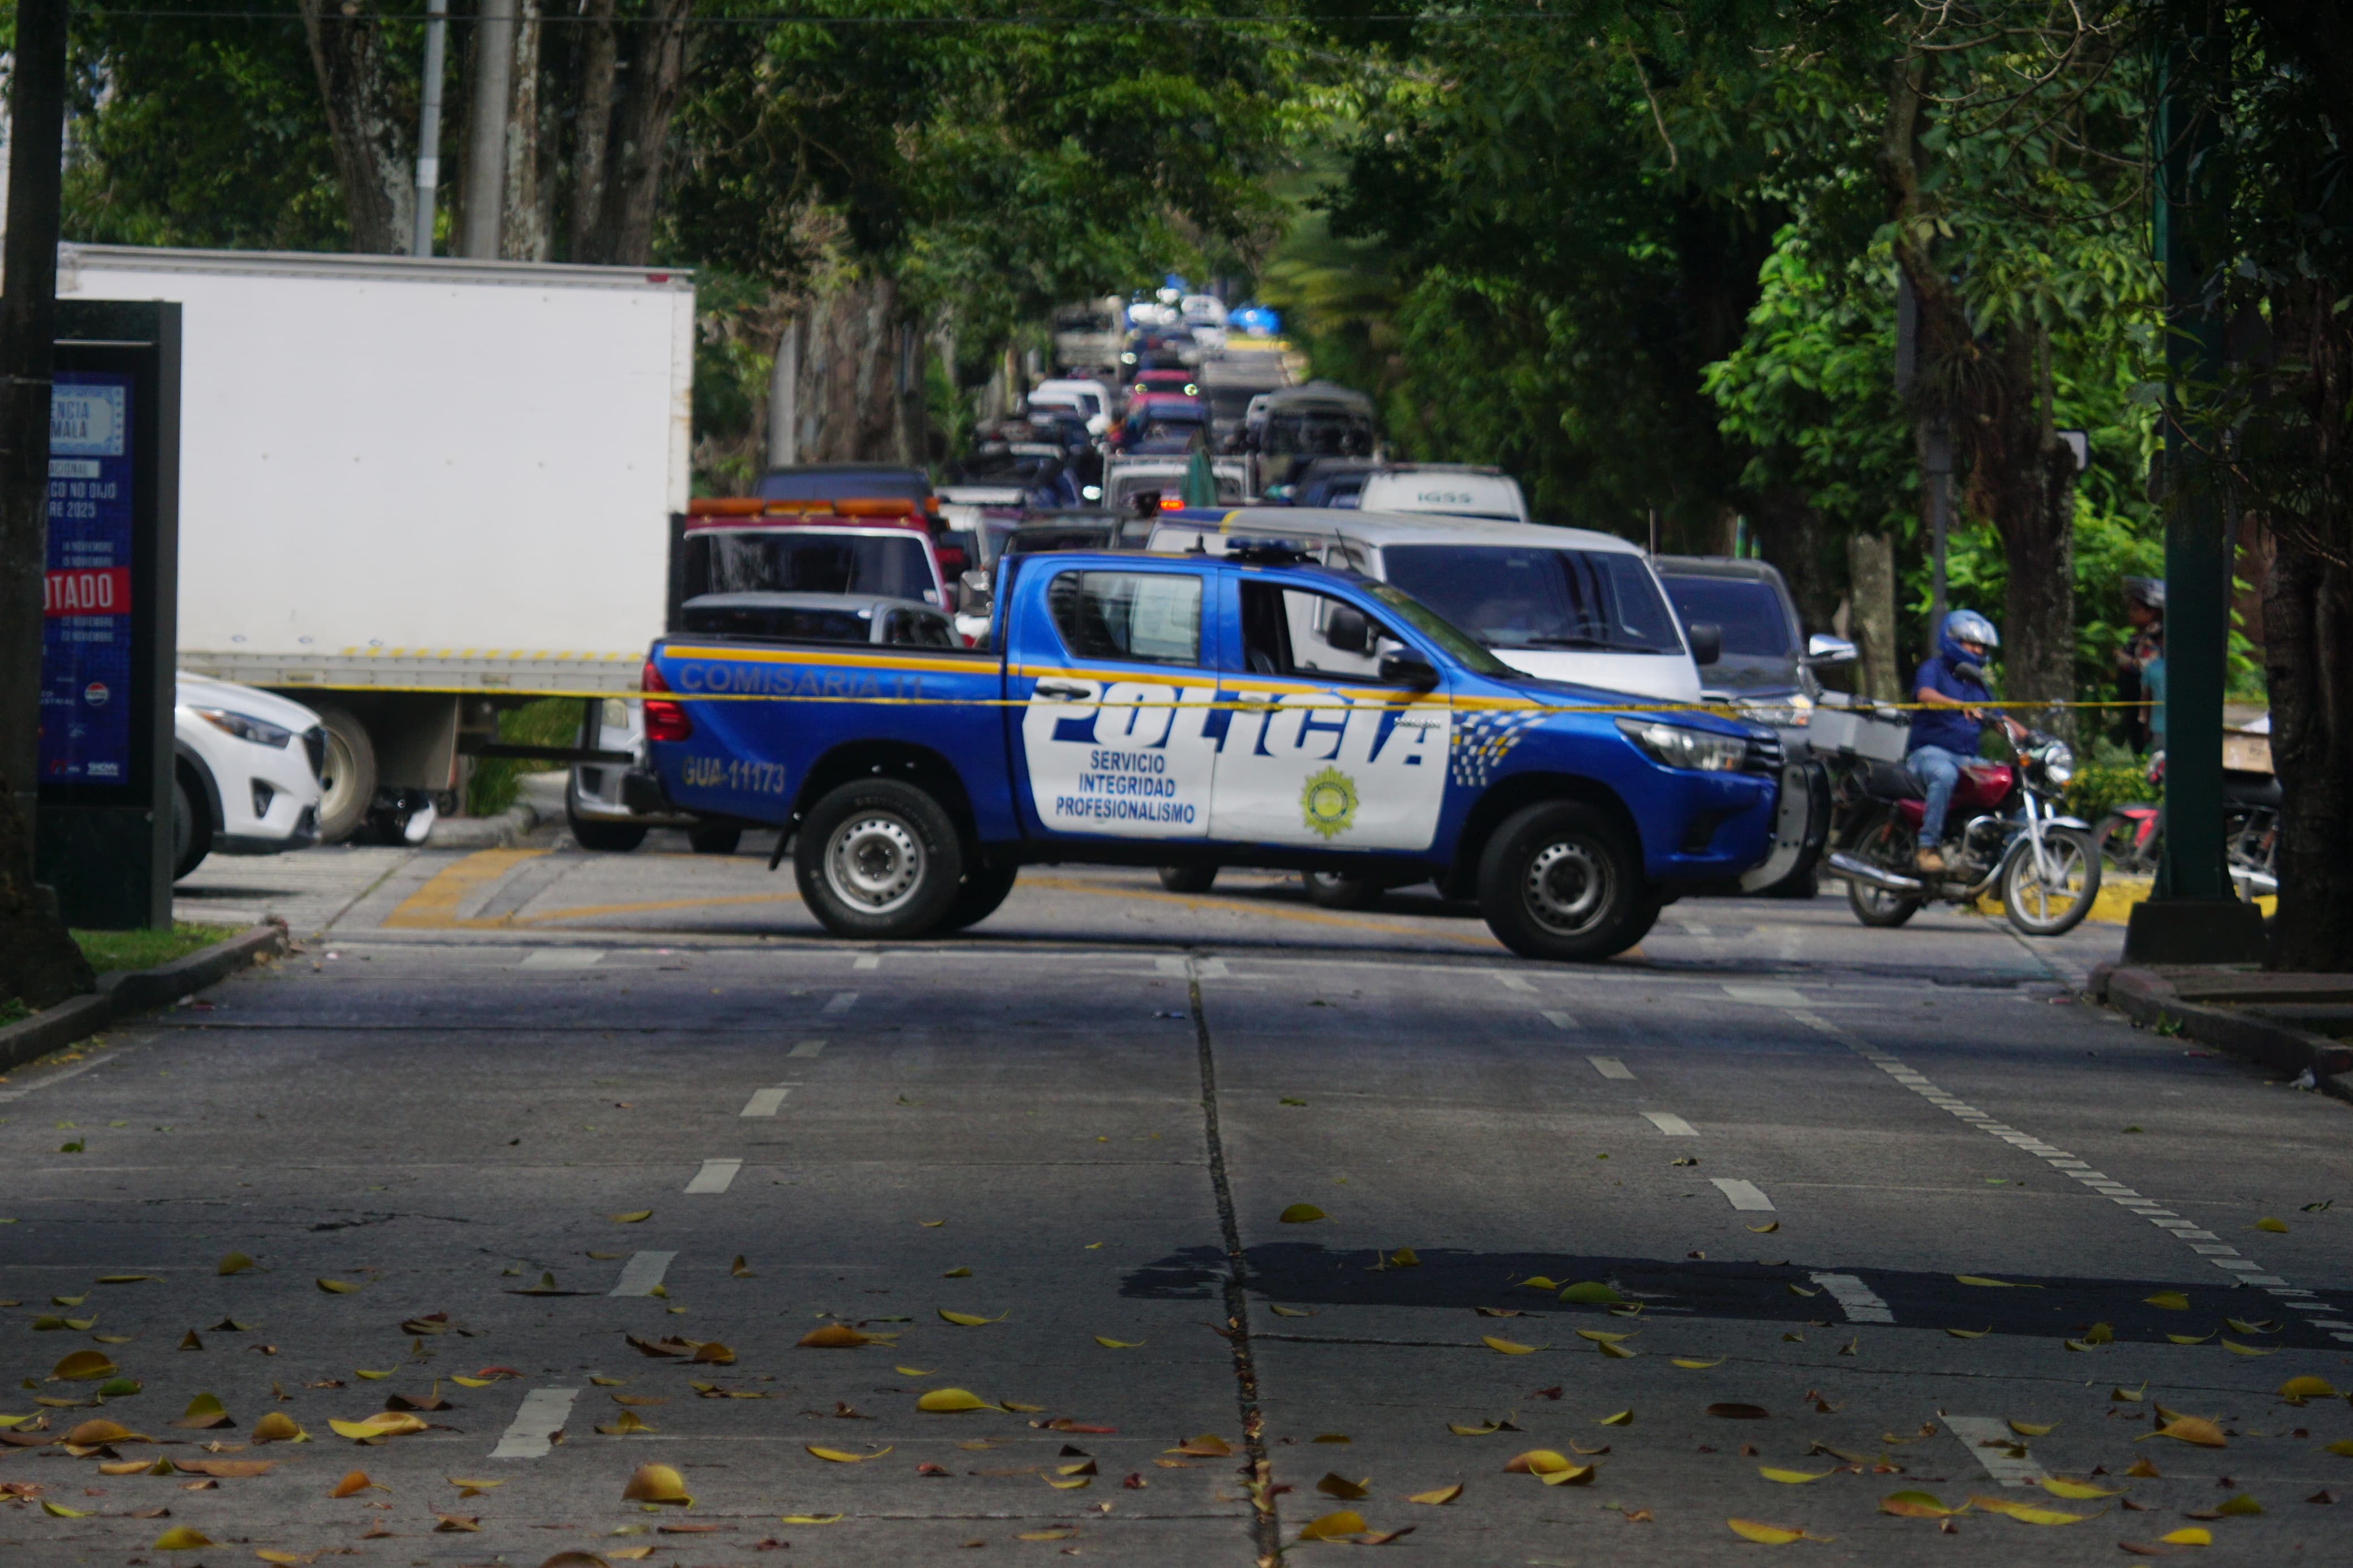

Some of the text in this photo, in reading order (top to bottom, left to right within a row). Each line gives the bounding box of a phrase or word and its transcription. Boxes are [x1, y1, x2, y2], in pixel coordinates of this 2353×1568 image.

[70, 482, 86, 498] NO
[89, 482, 117, 499] DIJO
[66, 501, 97, 517] 2025
[680, 663, 924, 700] COMISARIA 11
[1025, 676, 1445, 765] POLICIA
[683, 755, 785, 793] GUA-11173
[1090, 750, 1165, 774] SERVICIO
[1079, 773, 1175, 798] INTEGRIDAD
[1056, 796, 1195, 824] PROFESIONALISMO
